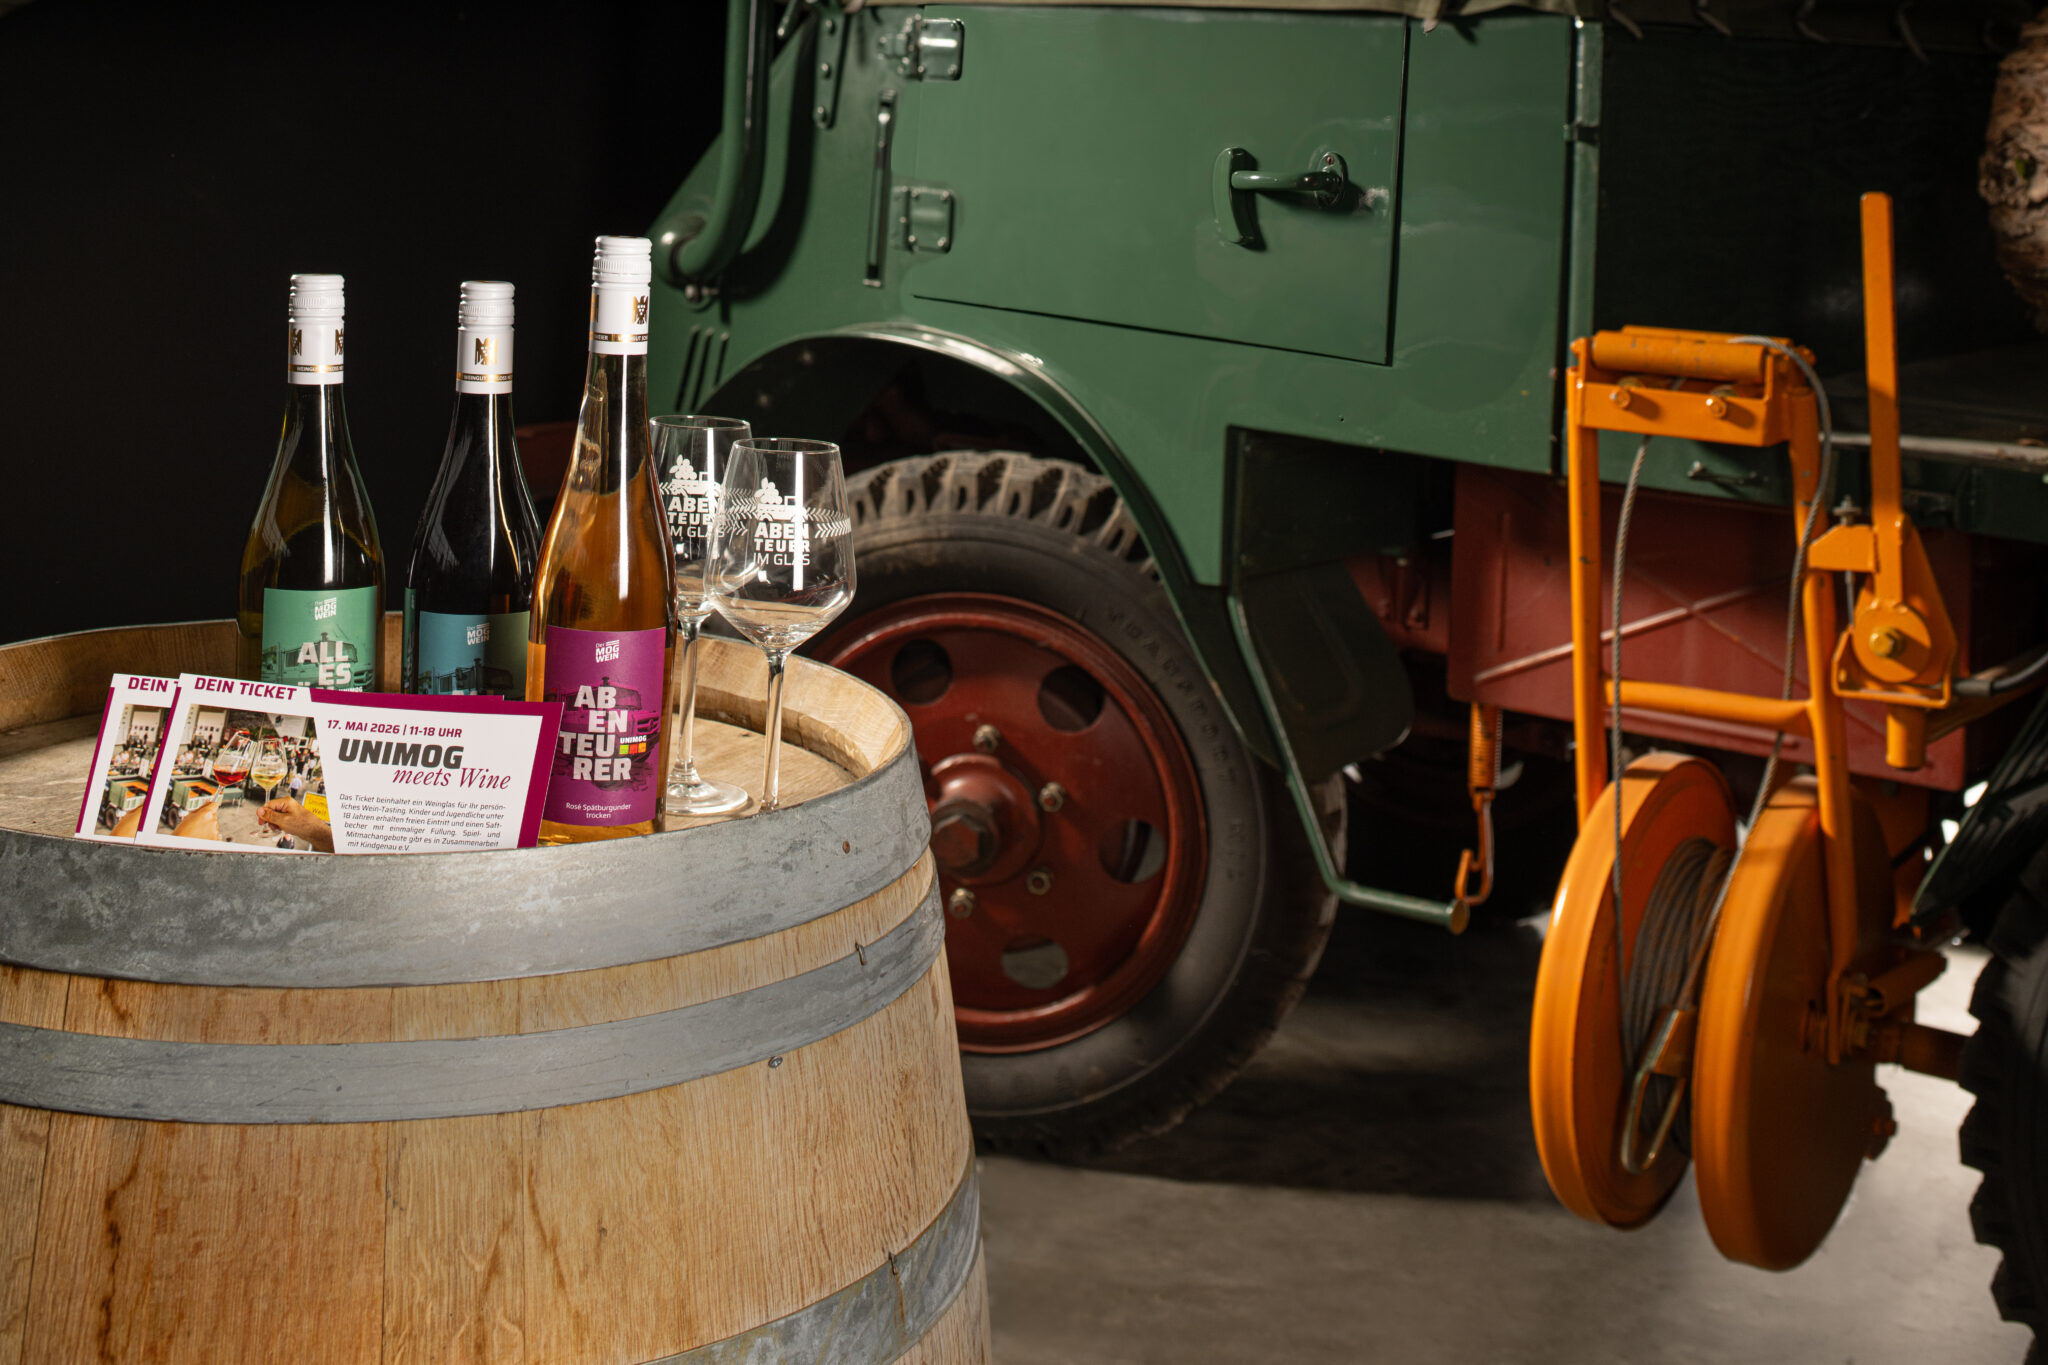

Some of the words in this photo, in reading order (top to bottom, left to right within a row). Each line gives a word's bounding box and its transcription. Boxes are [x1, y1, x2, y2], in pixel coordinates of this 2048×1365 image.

[670, 526, 683, 537] M
[754, 522, 809, 539] ABEN
[754, 538, 811, 552] TEUER
[753, 552, 769, 565] IM
[314, 602, 337, 613] MOG
[314, 610, 337, 620] WEIN
[467, 628, 490, 638] MOG
[467, 636, 490, 646] WEIN
[297, 640, 349, 664] ALL
[596, 644, 620, 656] MOG
[596, 652, 620, 664] WEIN
[318, 663, 352, 686] ES
[128, 677, 168, 693] DEIN
[194, 677, 235, 694] DEIN
[240, 682, 298, 700] TICKET
[574, 685, 617, 710] AB
[327, 720, 342, 730] 17.
[344, 721, 368, 732] MAI
[370, 723, 400, 734] 2026
[409, 726, 438, 737] 11-18
[438, 727, 463, 738] UHR
[588, 710, 628, 733] EN
[559, 730, 616, 757] TEU
[620, 734, 648, 745] UNIMOG
[338, 738, 465, 769] UNIMOG
[572, 757, 632, 782] RER
[392, 768, 452, 787] meets
[459, 768, 512, 790] Wine
[340, 793, 352, 801] Das
[354, 795, 374, 803] Ticket
[376, 796, 411, 805] beinhaltet
[425, 800, 456, 809] Weinglas
[566, 802, 582, 811] Rosé
[582, 803, 632, 812] Spätburgunder
[340, 803, 360, 811] liches
[408, 808, 432, 816] Kinder
[446, 810, 485, 818] Jugendliche
[486, 812, 504, 820] unter
[586, 812, 611, 820] trocken
[344, 822, 368, 830] becher
[390, 826, 425, 834] einmaliger
[352, 813, 374, 821] Jahren
[376, 815, 404, 823] erhalten
[406, 817, 425, 825] freien
[426, 818, 450, 826] Eintritt
[450, 820, 464, 828] und
[346, 830, 408, 842] Mitmachangebote
[408, 836, 422, 844] gibt
[442, 838, 499, 847] Zusammenarbeit
[360, 842, 398, 851] Kindgenau
